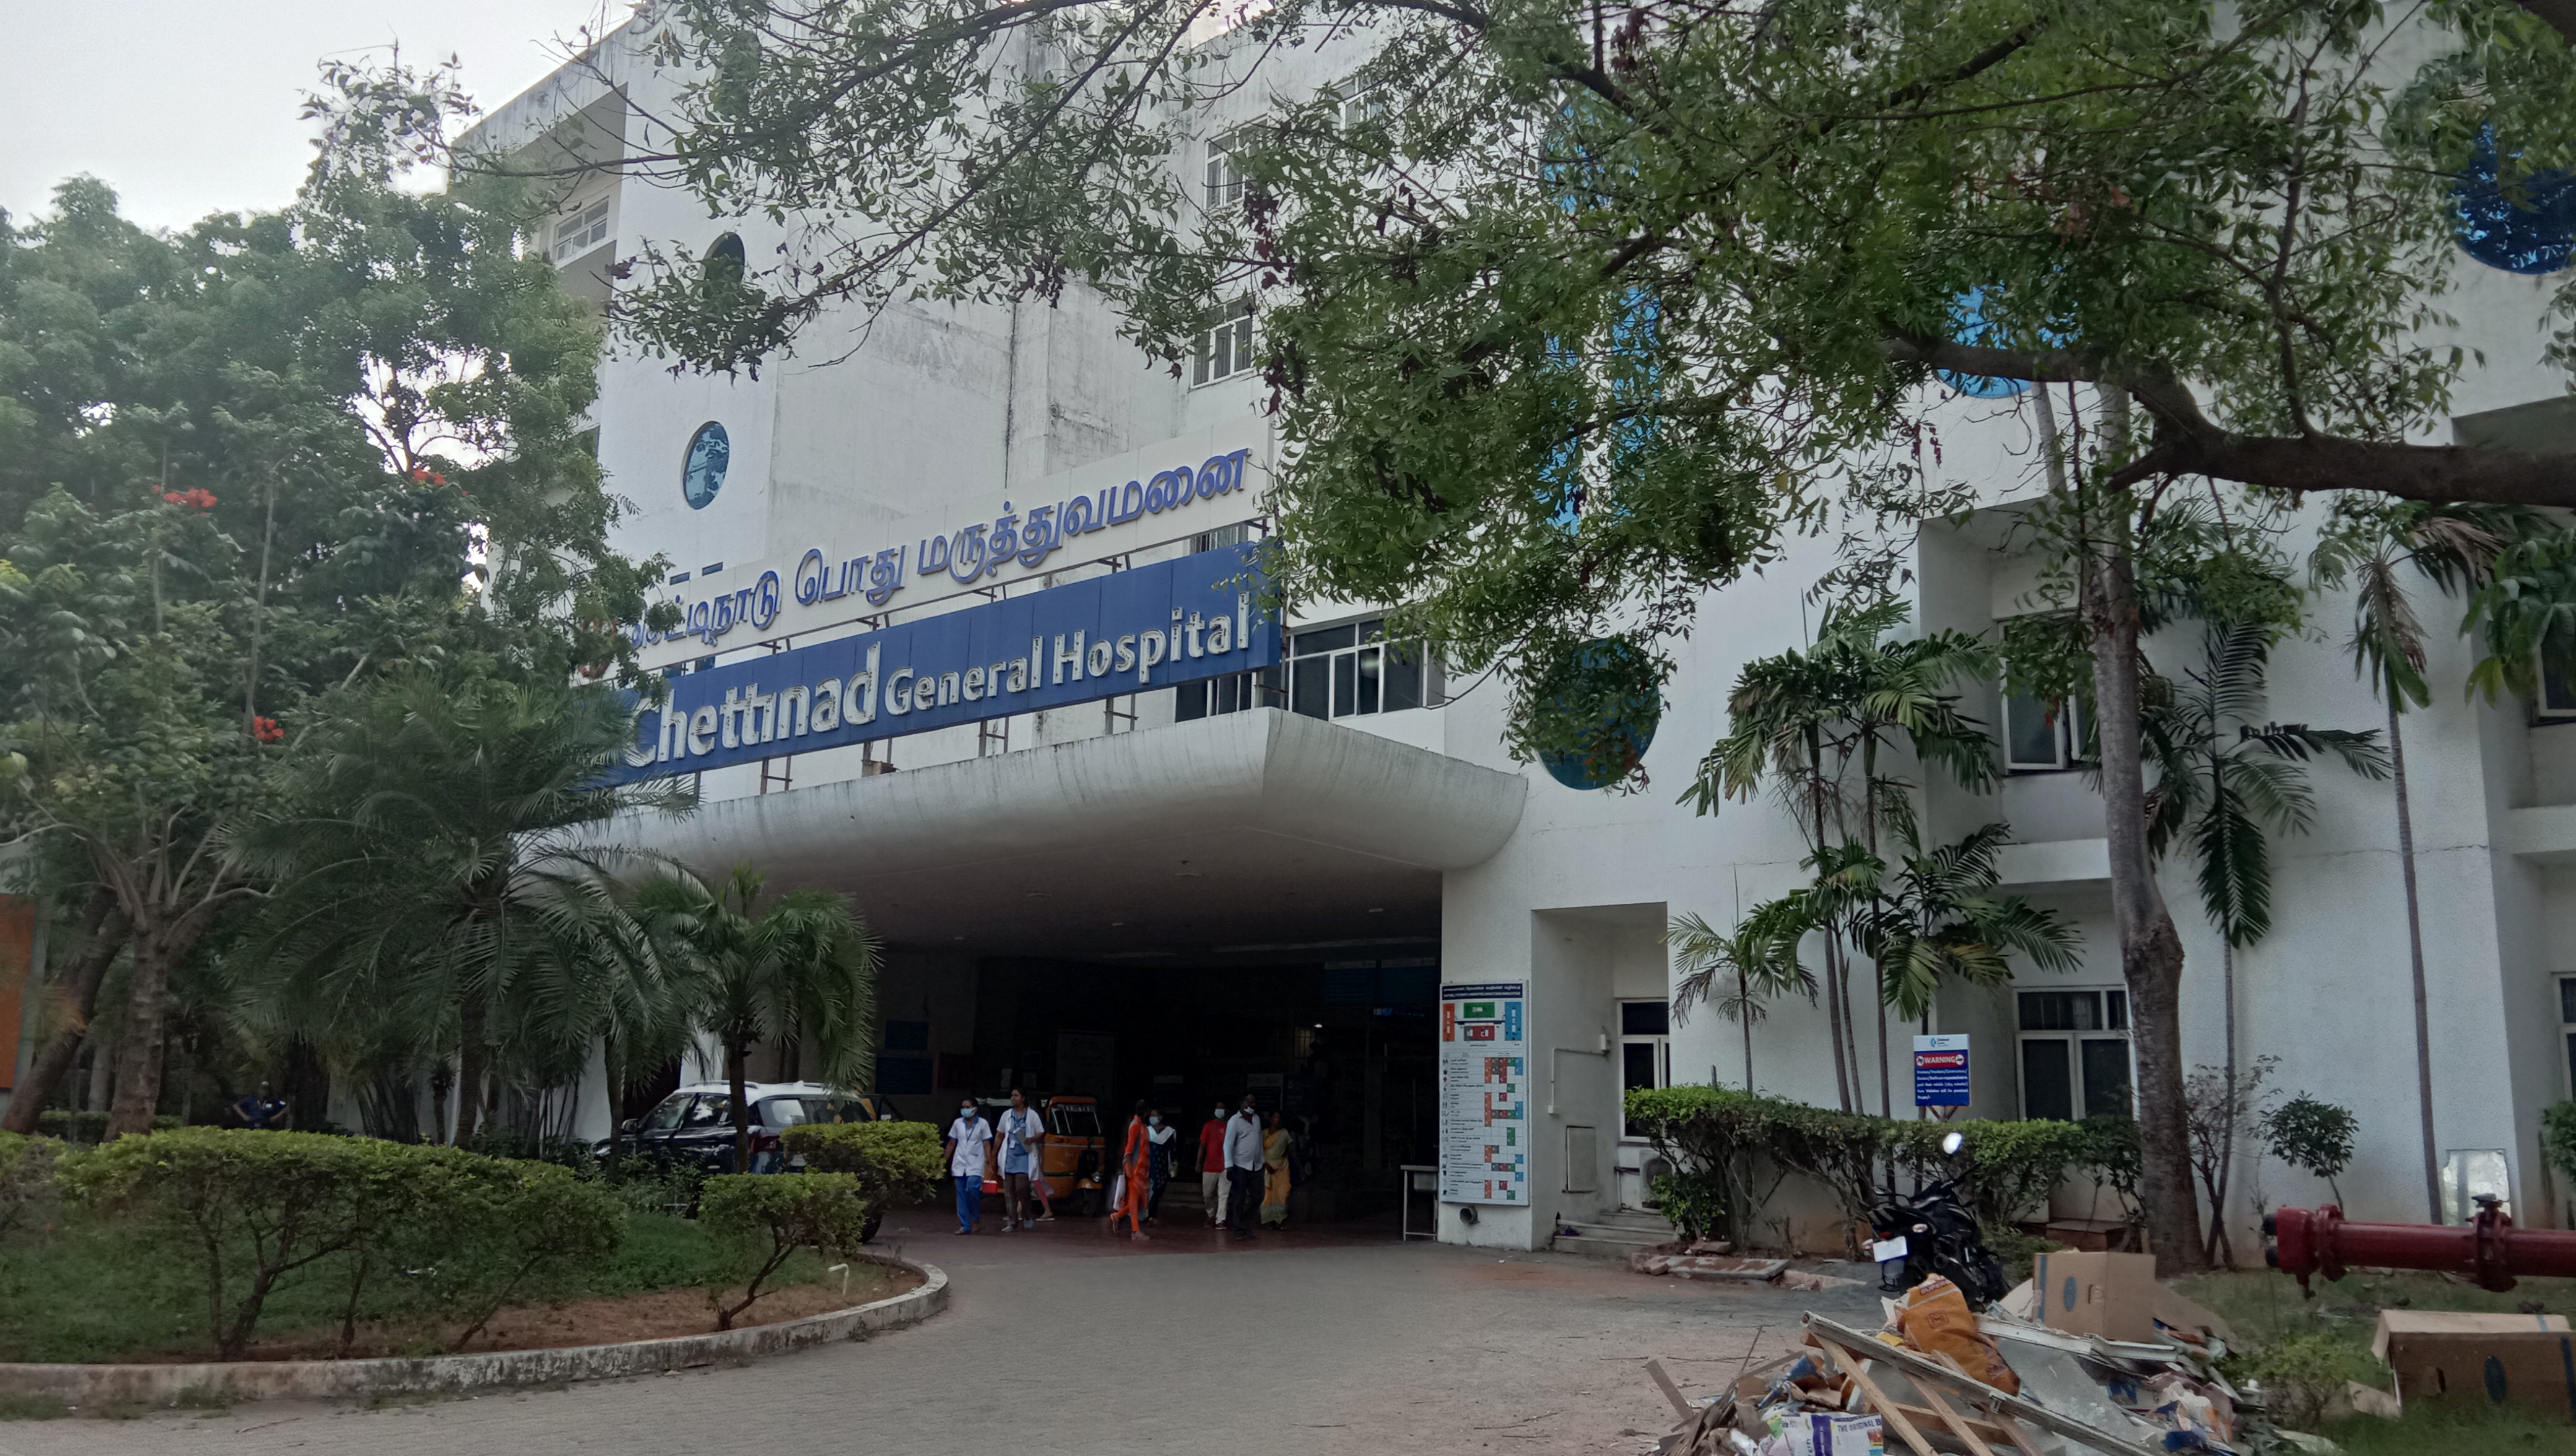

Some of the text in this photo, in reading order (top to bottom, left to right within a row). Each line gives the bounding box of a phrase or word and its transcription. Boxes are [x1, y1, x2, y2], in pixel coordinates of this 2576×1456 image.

[795, 545, 906, 605] பொது
[917, 448, 1252, 584] மருத்துவமனை
[622, 591, 1250, 768] Chettinad General Hospital
[1924, 1055, 1956, 1064] WARNING
[1837, 1424, 1848, 1432] THE
[1849, 1419, 1875, 1431] ORIGINAL
